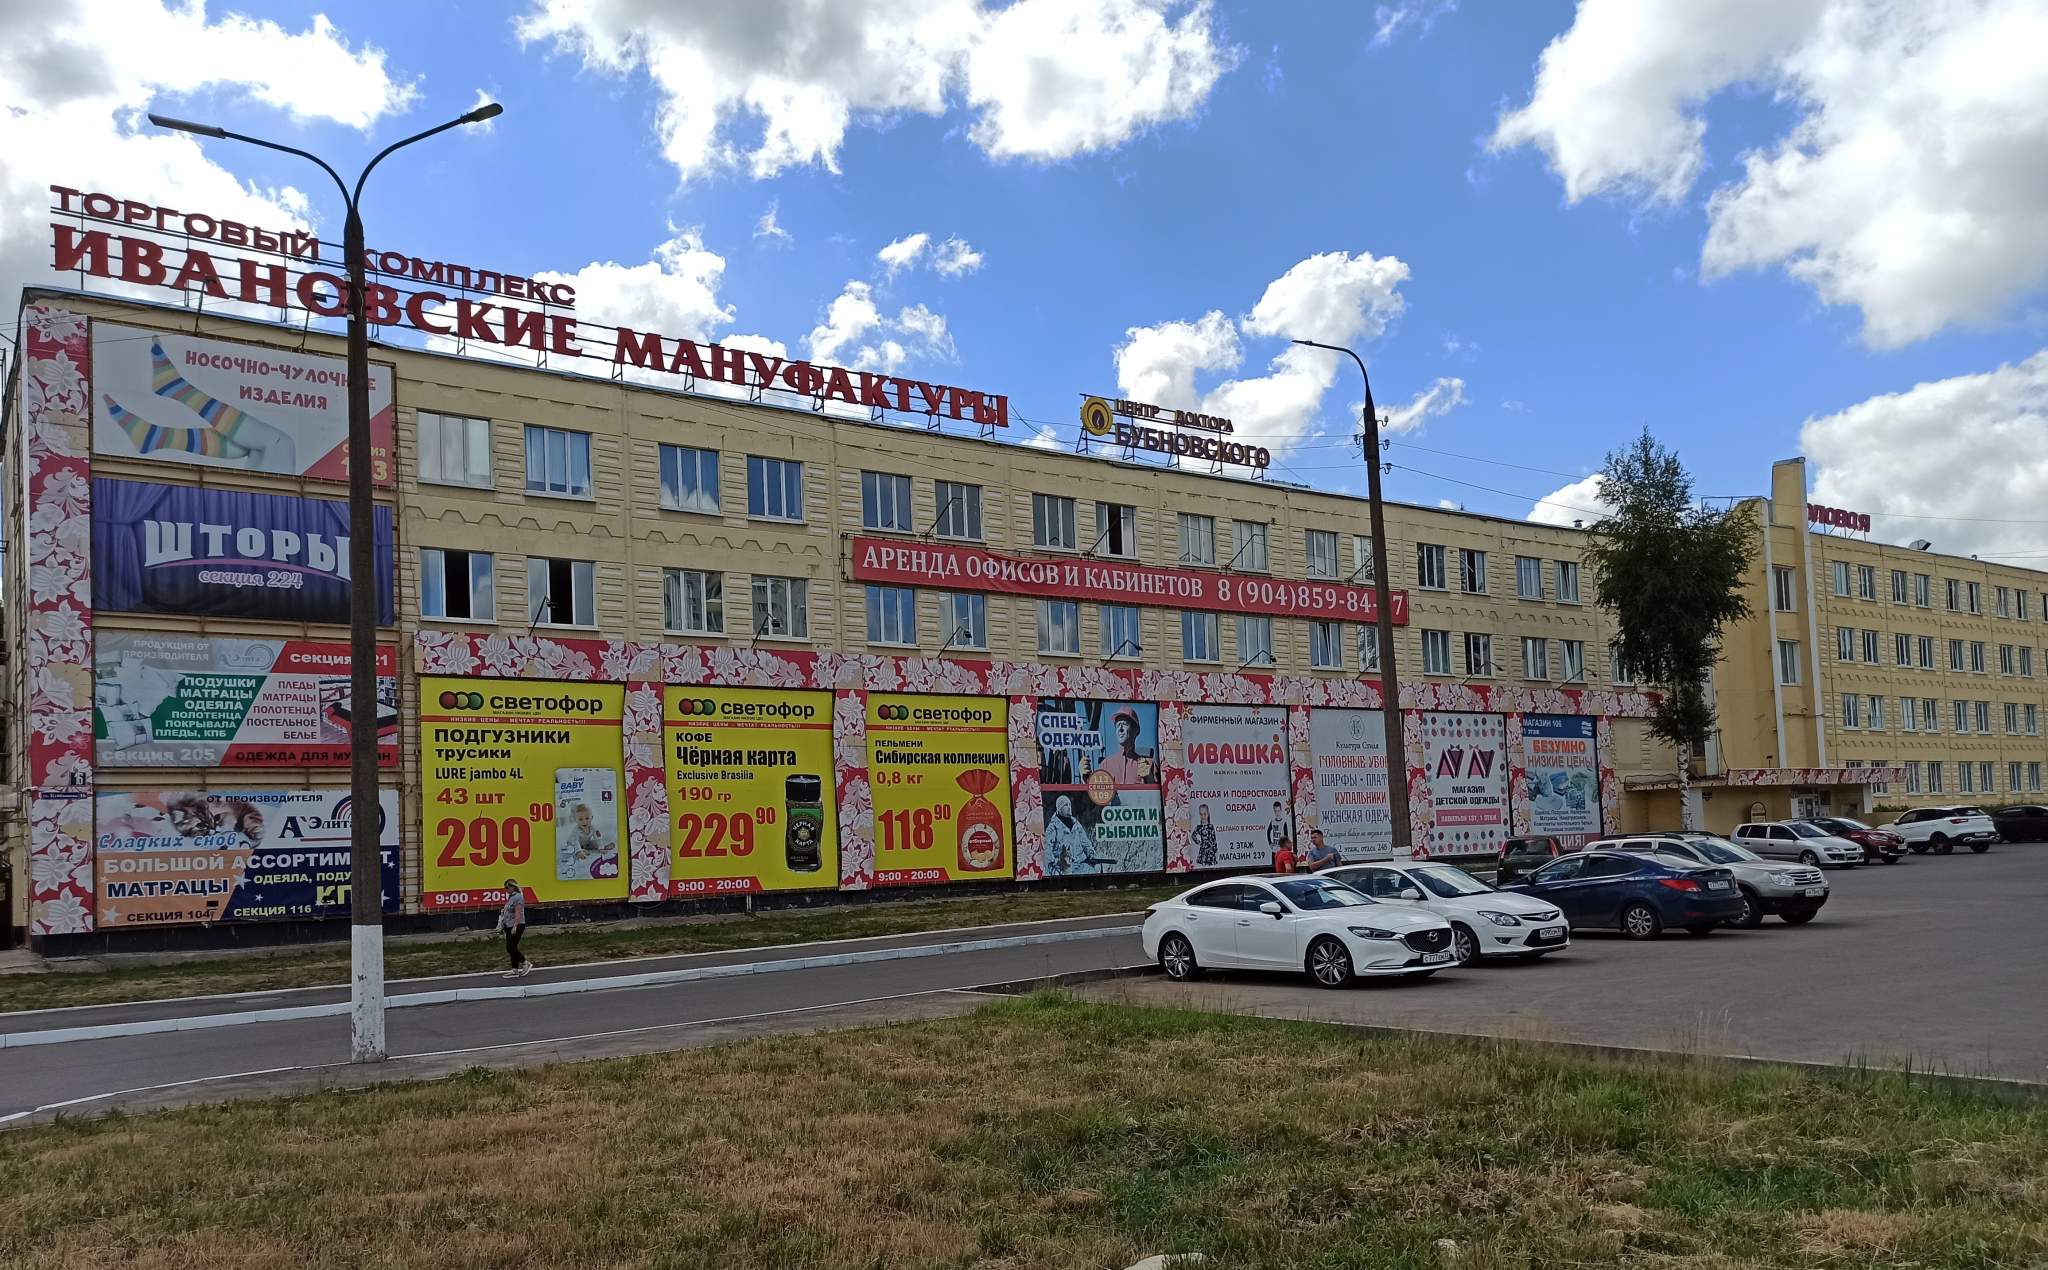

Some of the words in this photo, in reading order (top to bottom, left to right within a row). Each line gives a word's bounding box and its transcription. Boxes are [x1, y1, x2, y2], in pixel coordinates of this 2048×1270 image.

[50, 185, 320, 260] ТОРГОВЫЙ
[50, 223, 583, 357] ИВАНОВСКИЕ
[614, 327, 1010, 427] МАНУФАКТУРЫ
[186, 350, 376, 391] НОСОЧНО-ЧУЛОЧНЕ
[239, 385, 328, 410] ИЗДЕЛИЯ
[1115, 399, 1160, 418] ЦЕНТР
[1175, 410, 1234, 432] ДОКТОРА
[1115, 423, 1270, 468] БУБНОВСКОГО
[341, 457, 387, 480] 13
[144, 519, 351, 582] ШТОРЫ
[199, 570, 264, 588] секция
[267, 570, 303, 588] 224
[863, 545, 960, 579] АРЕНДА
[966, 556, 1059, 585] ОФИСОВ
[1064, 565, 1079, 587] И
[1085, 567, 1203, 598] КАБИНЕТОВ
[1218, 579, 1230, 601] 8
[1238, 581, 1403, 616] (904)859-84-7
[134, 640, 194, 650] ПРОДУКЦИЯ
[123, 651, 209, 661] ПРОИЗВОДИТЕЛЯ
[290, 653, 351, 666] секция
[184, 677, 256, 688] ПОДУШКИ
[279, 681, 316, 690] ПЛЕДЫ
[181, 689, 253, 700] МАТРАЦЫ
[263, 693, 316, 702] МАТРАЦЫ
[185, 700, 244, 711] ОДЕЯЛА
[490, 695, 603, 713] светофор
[172, 711, 241, 720] ПОЛОТЕНЦА
[253, 706, 316, 715] ПОЛОТЕНЦА
[721, 702, 814, 720] светофор
[913, 708, 992, 723] светофор
[166, 720, 236, 729] ПОКРЫВАЛА
[247, 718, 316, 727] ПОСТЕЛЬНОЕ
[1041, 716, 1081, 728] СПЕЦ-
[1190, 715, 1242, 725] ФИРМЕННЫЙ
[156, 729, 201, 738] ПЛЕДЫ,
[284, 731, 317, 740] БЕЛЬЕ
[435, 729, 570, 745] ПОДГУЗНИКИ
[676, 733, 712, 742] КОФЕ
[1041, 733, 1100, 746] ОДЕЖДА
[1188, 741, 1284, 764] ИВАШКА
[1533, 740, 1586, 753] БЕЗУМНО
[102, 750, 174, 761] секция
[181, 749, 216, 761] 205
[236, 752, 296, 761] ОДЕЖДА
[301, 752, 328, 761] ДЛЯ
[436, 749, 511, 761] трусики
[677, 746, 744, 767] Чёрная
[747, 750, 796, 767] карта
[876, 750, 940, 765] Сибирская
[944, 753, 1005, 766] коллекция
[1319, 756, 1366, 768] ГОЛОВНЫЕ
[1528, 756, 1565, 767] НИЗКИЕ
[1567, 756, 1593, 769] ЦЕНЫ
[436, 768, 466, 779] LURE
[470, 768, 507, 782] jambo
[510, 768, 523, 779] 4L
[677, 770, 719, 779] Exclusive
[722, 771, 754, 780] Brasilia
[876, 771, 901, 786] 0,8
[907, 775, 923, 784] кг
[1321, 774, 1357, 786] ШАРФЫ
[436, 788, 468, 804] 43
[476, 793, 505, 804] шт
[678, 787, 712, 800] 190
[718, 792, 731, 802] гр
[1190, 791, 1221, 799] ДЕТСКАЯ
[1232, 790, 1286, 798] ПОДРОСТКОВАЯ
[1452, 786, 1485, 794] МАГАЗИН
[226, 795, 322, 804] ПРОИЗВОДИТЕЛЯ
[1335, 791, 1387, 805] КУПАЛЬНИКИ
[1436, 797, 1468, 805] ДЕТСКОЙ
[1470, 797, 1500, 805] ОДЕЖДЫ
[1226, 804, 1256, 812] ОДЕЖДА
[1104, 809, 1145, 821] ОХОТА
[1149, 809, 1157, 820] И
[1322, 811, 1362, 823] ЖЕНСКАЯ
[678, 813, 754, 858] 229
[756, 807, 775, 824] 90
[878, 808, 933, 850] 118
[934, 804, 950, 820] 90
[1098, 825, 1158, 838] РЫБАЛКА
[436, 817, 531, 867] 299
[530, 803, 553, 822] 90
[99, 834, 183, 851] Сладких
[1219, 852, 1250, 860] МАГАЗИН
[104, 853, 224, 873] БОЛЬШОЙ
[254, 874, 312, 884] ОДЕЯЛА,
[879, 873, 902, 881] 9:00
[911, 871, 939, 880] 20:00
[107, 879, 228, 898] МАТРАЦЫ
[677, 882, 704, 891] 9:00
[717, 879, 749, 890] 20:00
[436, 893, 468, 904] 9:00
[127, 911, 182, 922] СЕКЦИЯ
[234, 907, 285, 916] СЕКЦИЯ
[290, 905, 312, 914] 116
